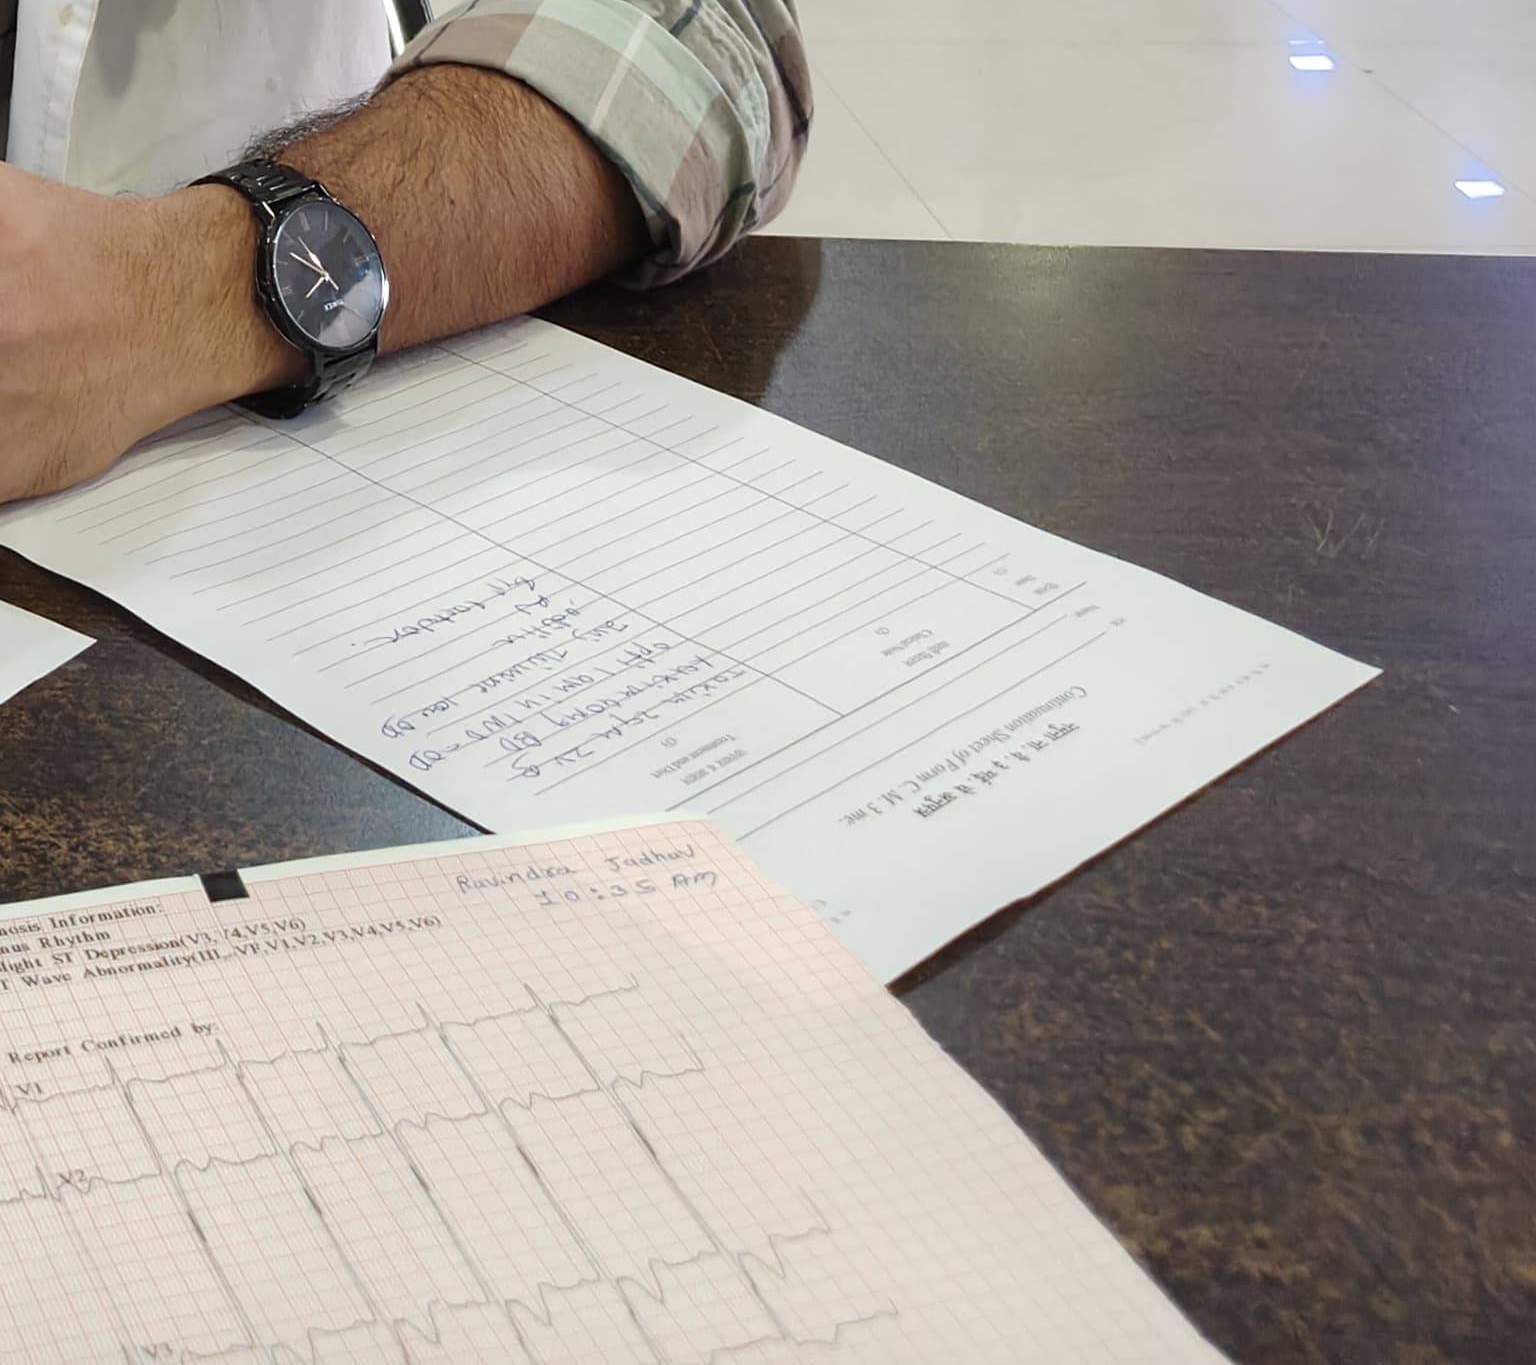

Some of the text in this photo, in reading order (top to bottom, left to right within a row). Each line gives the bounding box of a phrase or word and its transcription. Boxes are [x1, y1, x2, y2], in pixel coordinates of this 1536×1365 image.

[1003, 685, 1088, 733] Continuation
[967, 728, 1012, 754] Sheet
[951, 748, 972, 765] of
[915, 758, 961, 784] Form
[604, 843, 696, 873] Jadhav
[672, 871, 718, 889] AM
[49, 903, 163, 929] Information:
[39, 929, 112, 950] Rhythm
[52, 952, 75, 966] ST
[22, 972, 72, 989] Wave
[8, 1022, 219, 1064] Report Confirmed by:
[17, 1082, 44, 1096] V1
[58, 1169, 86, 1184] V2
[142, 1343, 173, 1358] V3
